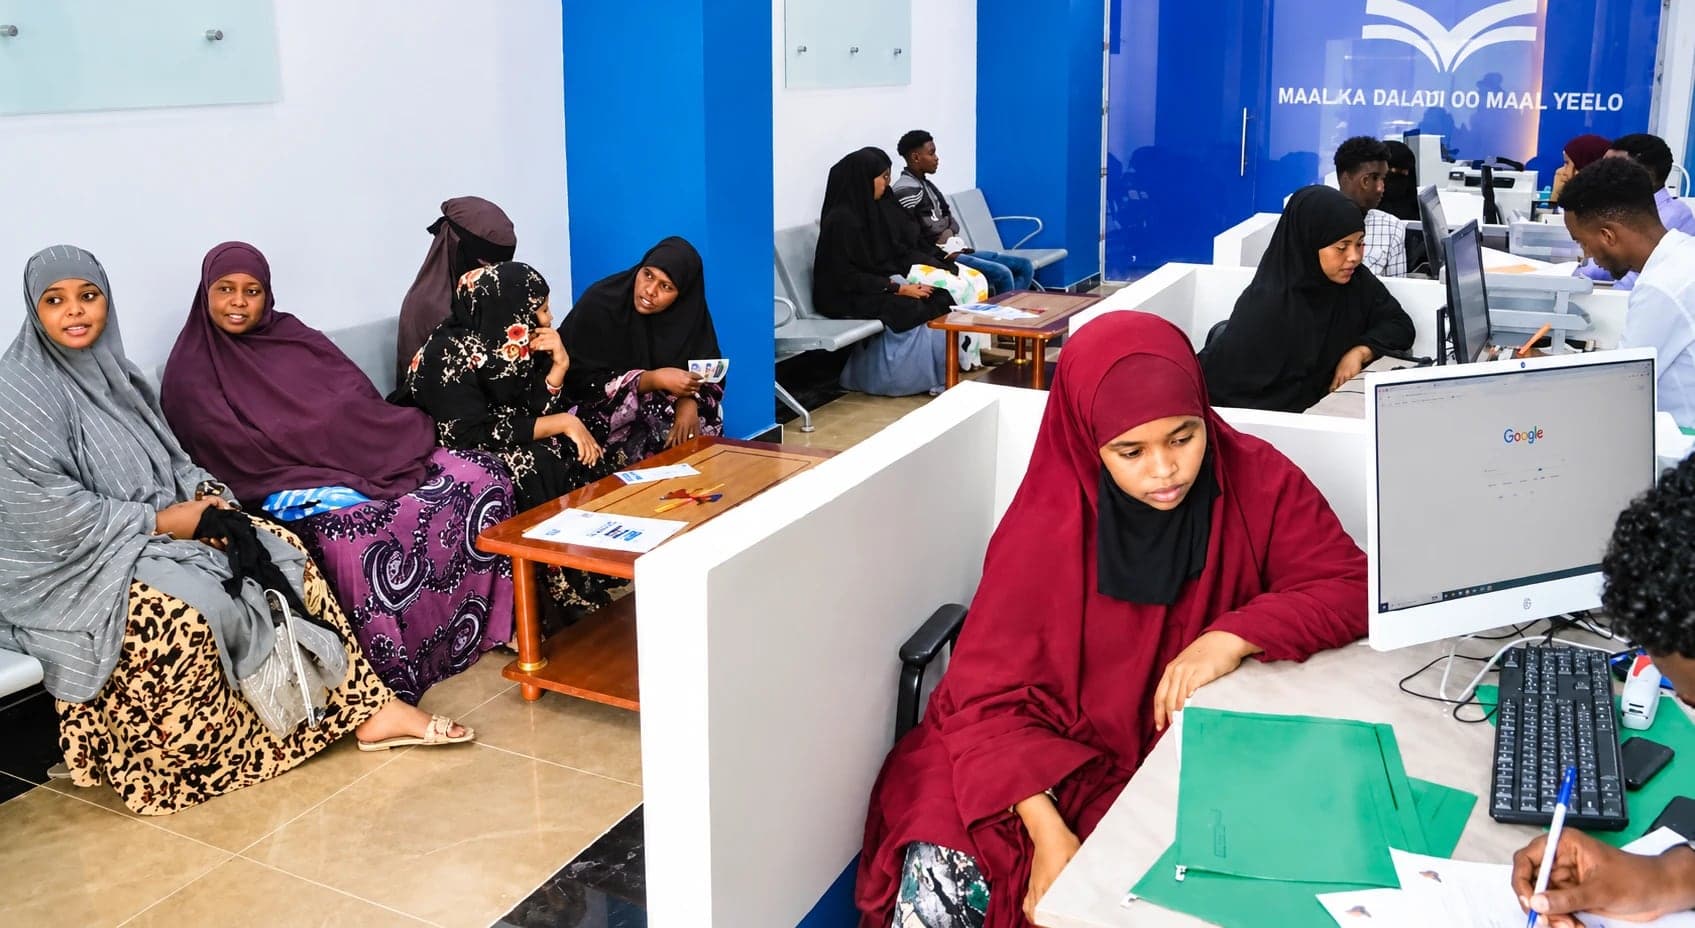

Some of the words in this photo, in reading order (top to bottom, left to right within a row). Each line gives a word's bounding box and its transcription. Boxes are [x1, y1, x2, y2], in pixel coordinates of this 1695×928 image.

[1373, 89, 1445, 108] DALADI
[1451, 90, 1480, 109] OO
[1486, 91, 1548, 110] MAAL
[1553, 92, 1624, 111] YEELO
[1503, 425, 1544, 445] Google
